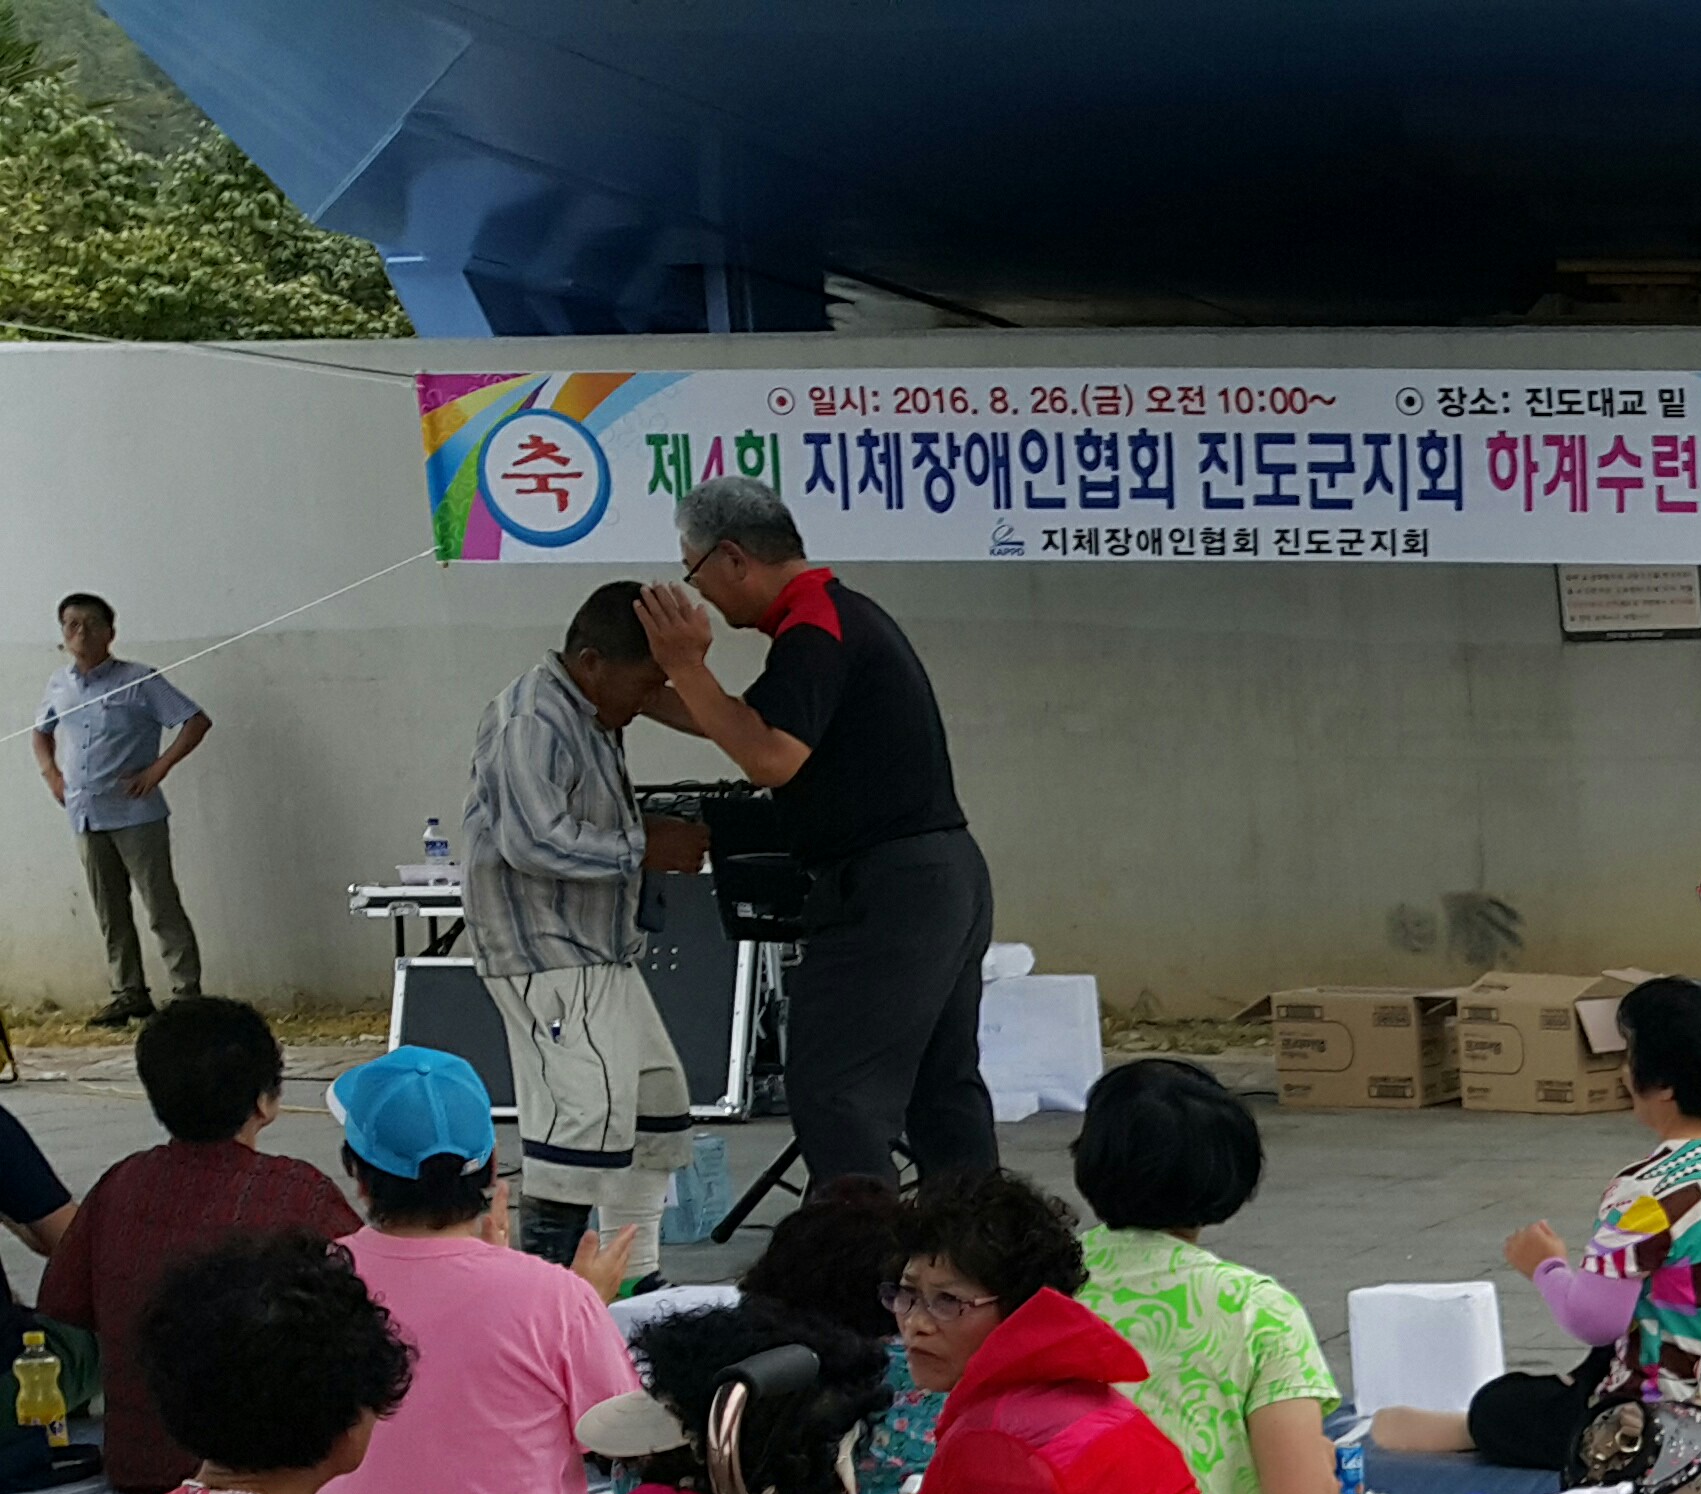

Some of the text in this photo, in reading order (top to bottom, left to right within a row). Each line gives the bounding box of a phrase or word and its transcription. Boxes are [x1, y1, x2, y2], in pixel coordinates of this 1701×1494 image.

[808, 384, 1336, 418] 일시: 2016. 8. 26.(금) 오전 10:00~
[1437, 387, 1686, 418] 장소: 진도대교 밑
[501, 434, 583, 513] 축
[803, 428, 1175, 513] 지체장애인협회
[1198, 429, 1463, 512] 진도군지회
[1041, 527, 1429, 557] 지체장애인협회 진도군지회
